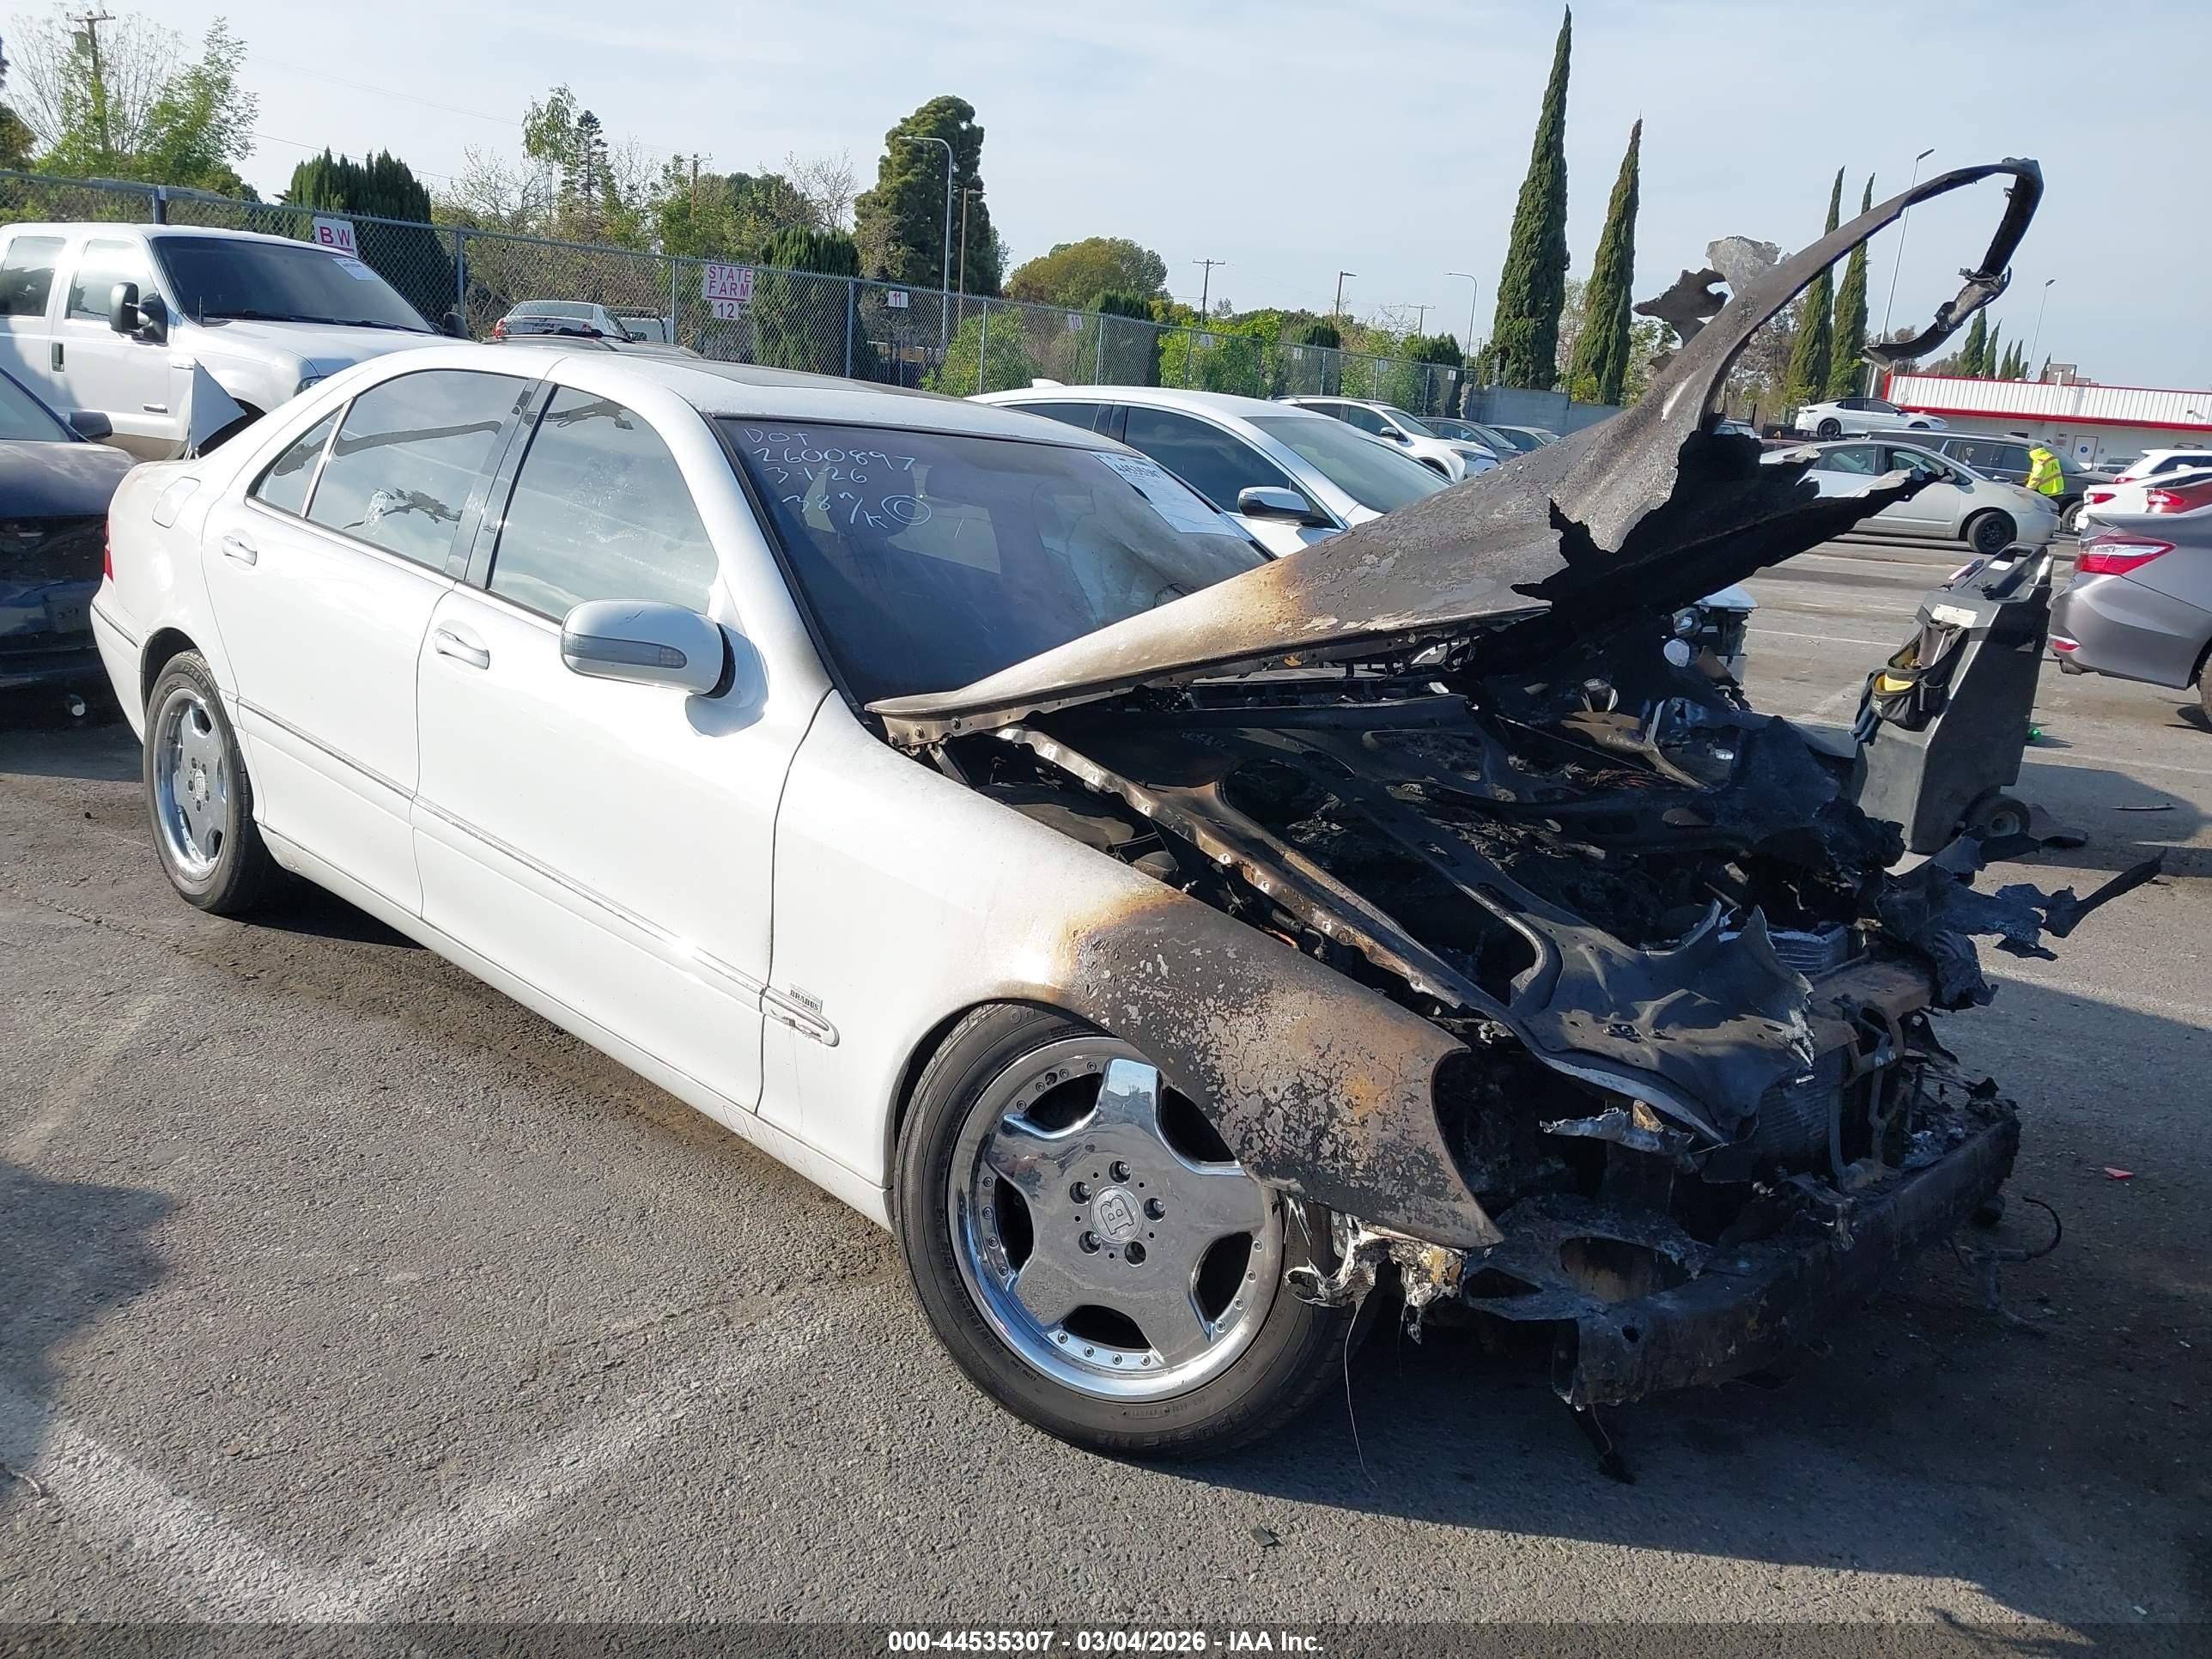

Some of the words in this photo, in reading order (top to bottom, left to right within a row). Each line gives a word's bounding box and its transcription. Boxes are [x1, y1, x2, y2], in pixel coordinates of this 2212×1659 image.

[319, 226, 350, 246] BW
[708, 265, 753, 283] STATE
[708, 280, 750, 297] FARM
[892, 291, 902, 307] 11
[718, 302, 736, 319] 12
[1071, 315, 1081, 329] 10
[1205, 335, 1210, 346] 9
[751, 447, 915, 471] 2600897
[763, 465, 867, 484] 3-1-26
[789, 988, 820, 1012] BRABUS
